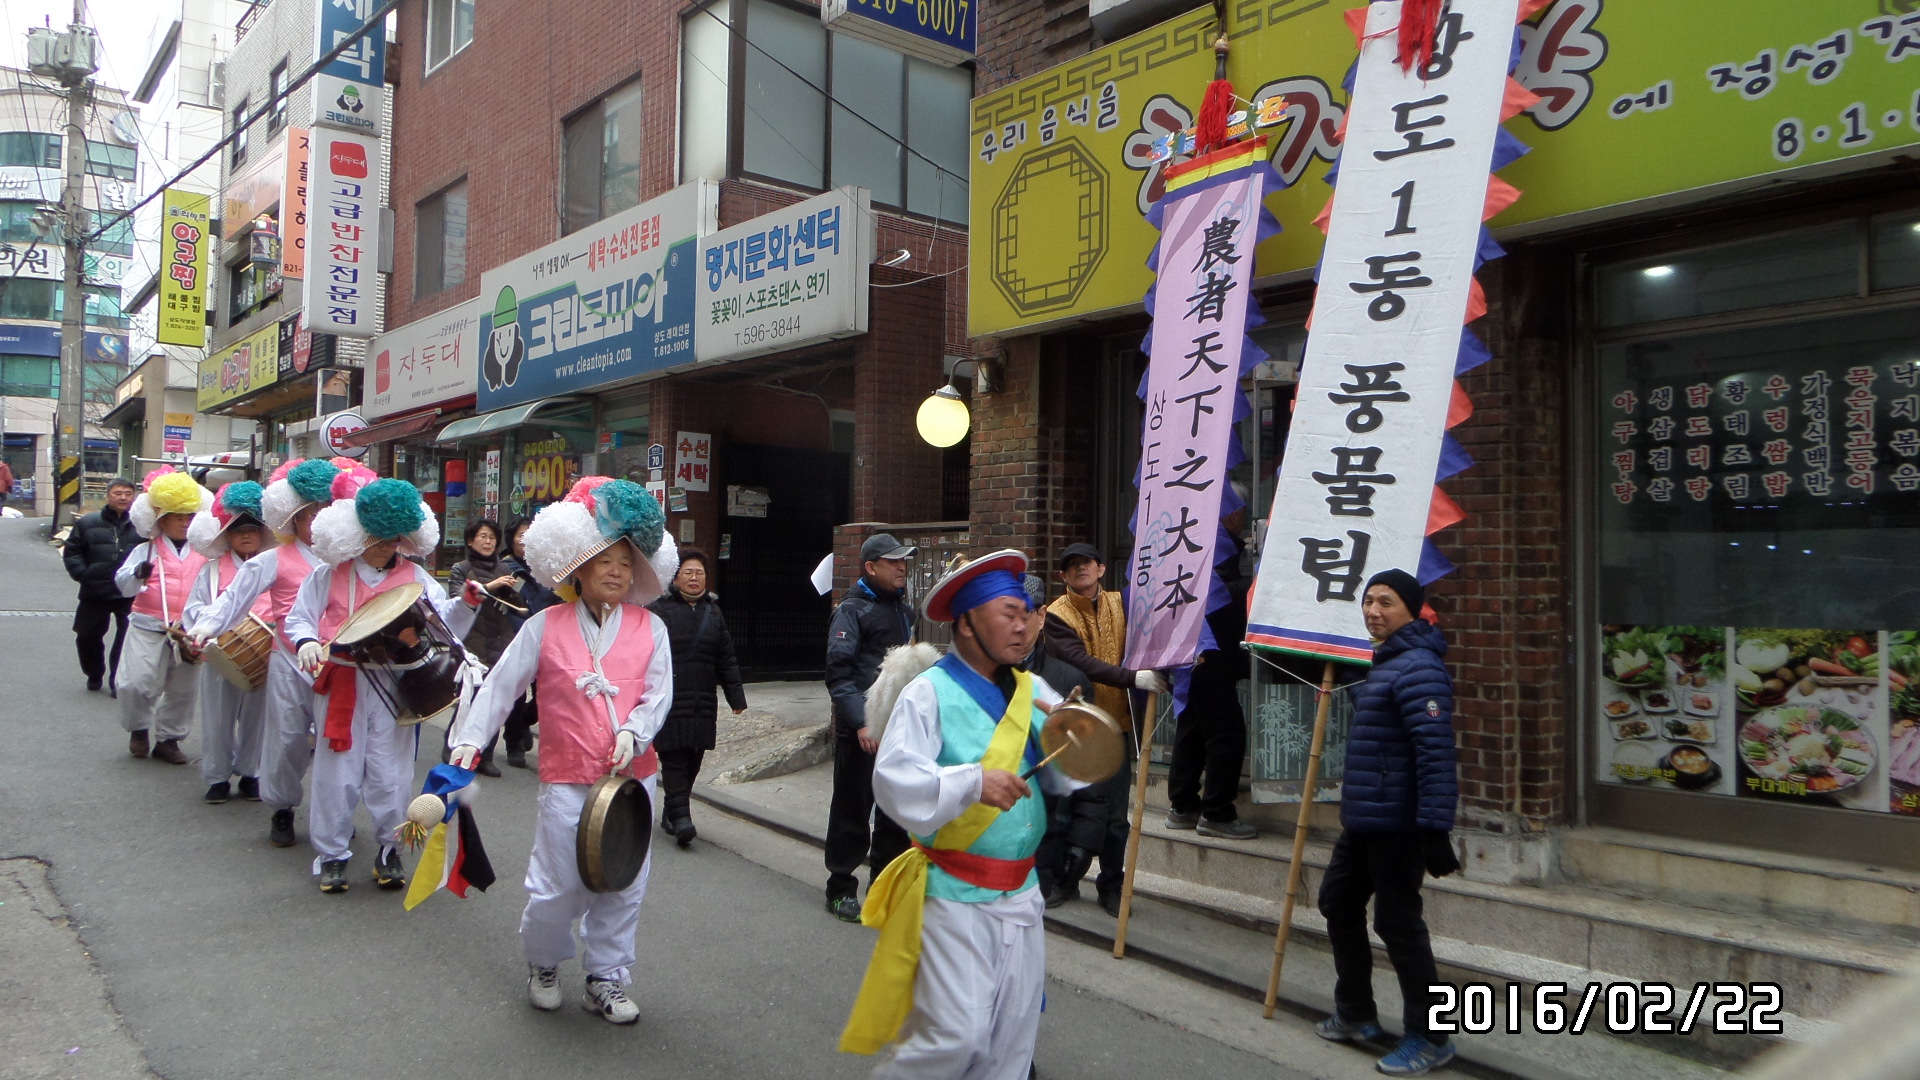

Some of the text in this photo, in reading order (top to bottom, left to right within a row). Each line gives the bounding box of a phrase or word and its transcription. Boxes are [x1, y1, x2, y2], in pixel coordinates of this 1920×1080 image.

[857, 0, 970, 40] -6007
[325, 110, 376, 129] 크린토피아
[980, 81, 1118, 164] 우리 음식을
[1612, 84, 1669, 116] 에
[171, 222, 201, 290] 아구찜
[326, 180, 364, 326] 고급반찬전문점
[532, 262, 545, 280] 나의
[546, 255, 559, 275] 생활
[560, 252, 570, 270] OK
[705, 205, 841, 293] 명지문화센터
[167, 302, 200, 314] 대구찜
[527, 267, 668, 361] 크린토피아
[734, 315, 801, 347] T.596-3844
[398, 333, 461, 381] 장독대
[555, 346, 632, 379] www.cleantopia.com
[653, 339, 690, 358] T.812-1006
[329, 426, 369, 448] 반
[1153, 216, 1242, 620] 農者天下之大本
[1723, 381, 1751, 500] 황태조림
[1763, 375, 1791, 498] 우렁쌈밥
[1803, 371, 1833, 495] 가정식백반
[1846, 366, 1877, 494] 묵은지고등어
[1891, 362, 1920, 491] 낙지볶음
[487, 455, 499, 471] 수선
[651, 456, 660, 467] 70
[678, 437, 709, 459] 수선
[1650, 386, 1675, 501] 생삼겹살
[1686, 384, 1712, 501] 닭도리탕
[524, 455, 565, 500] 990
[677, 462, 708, 484] 세탁
[1135, 388, 1168, 587] 상도1동
[1608, 761, 1678, 784] 가정식백반
